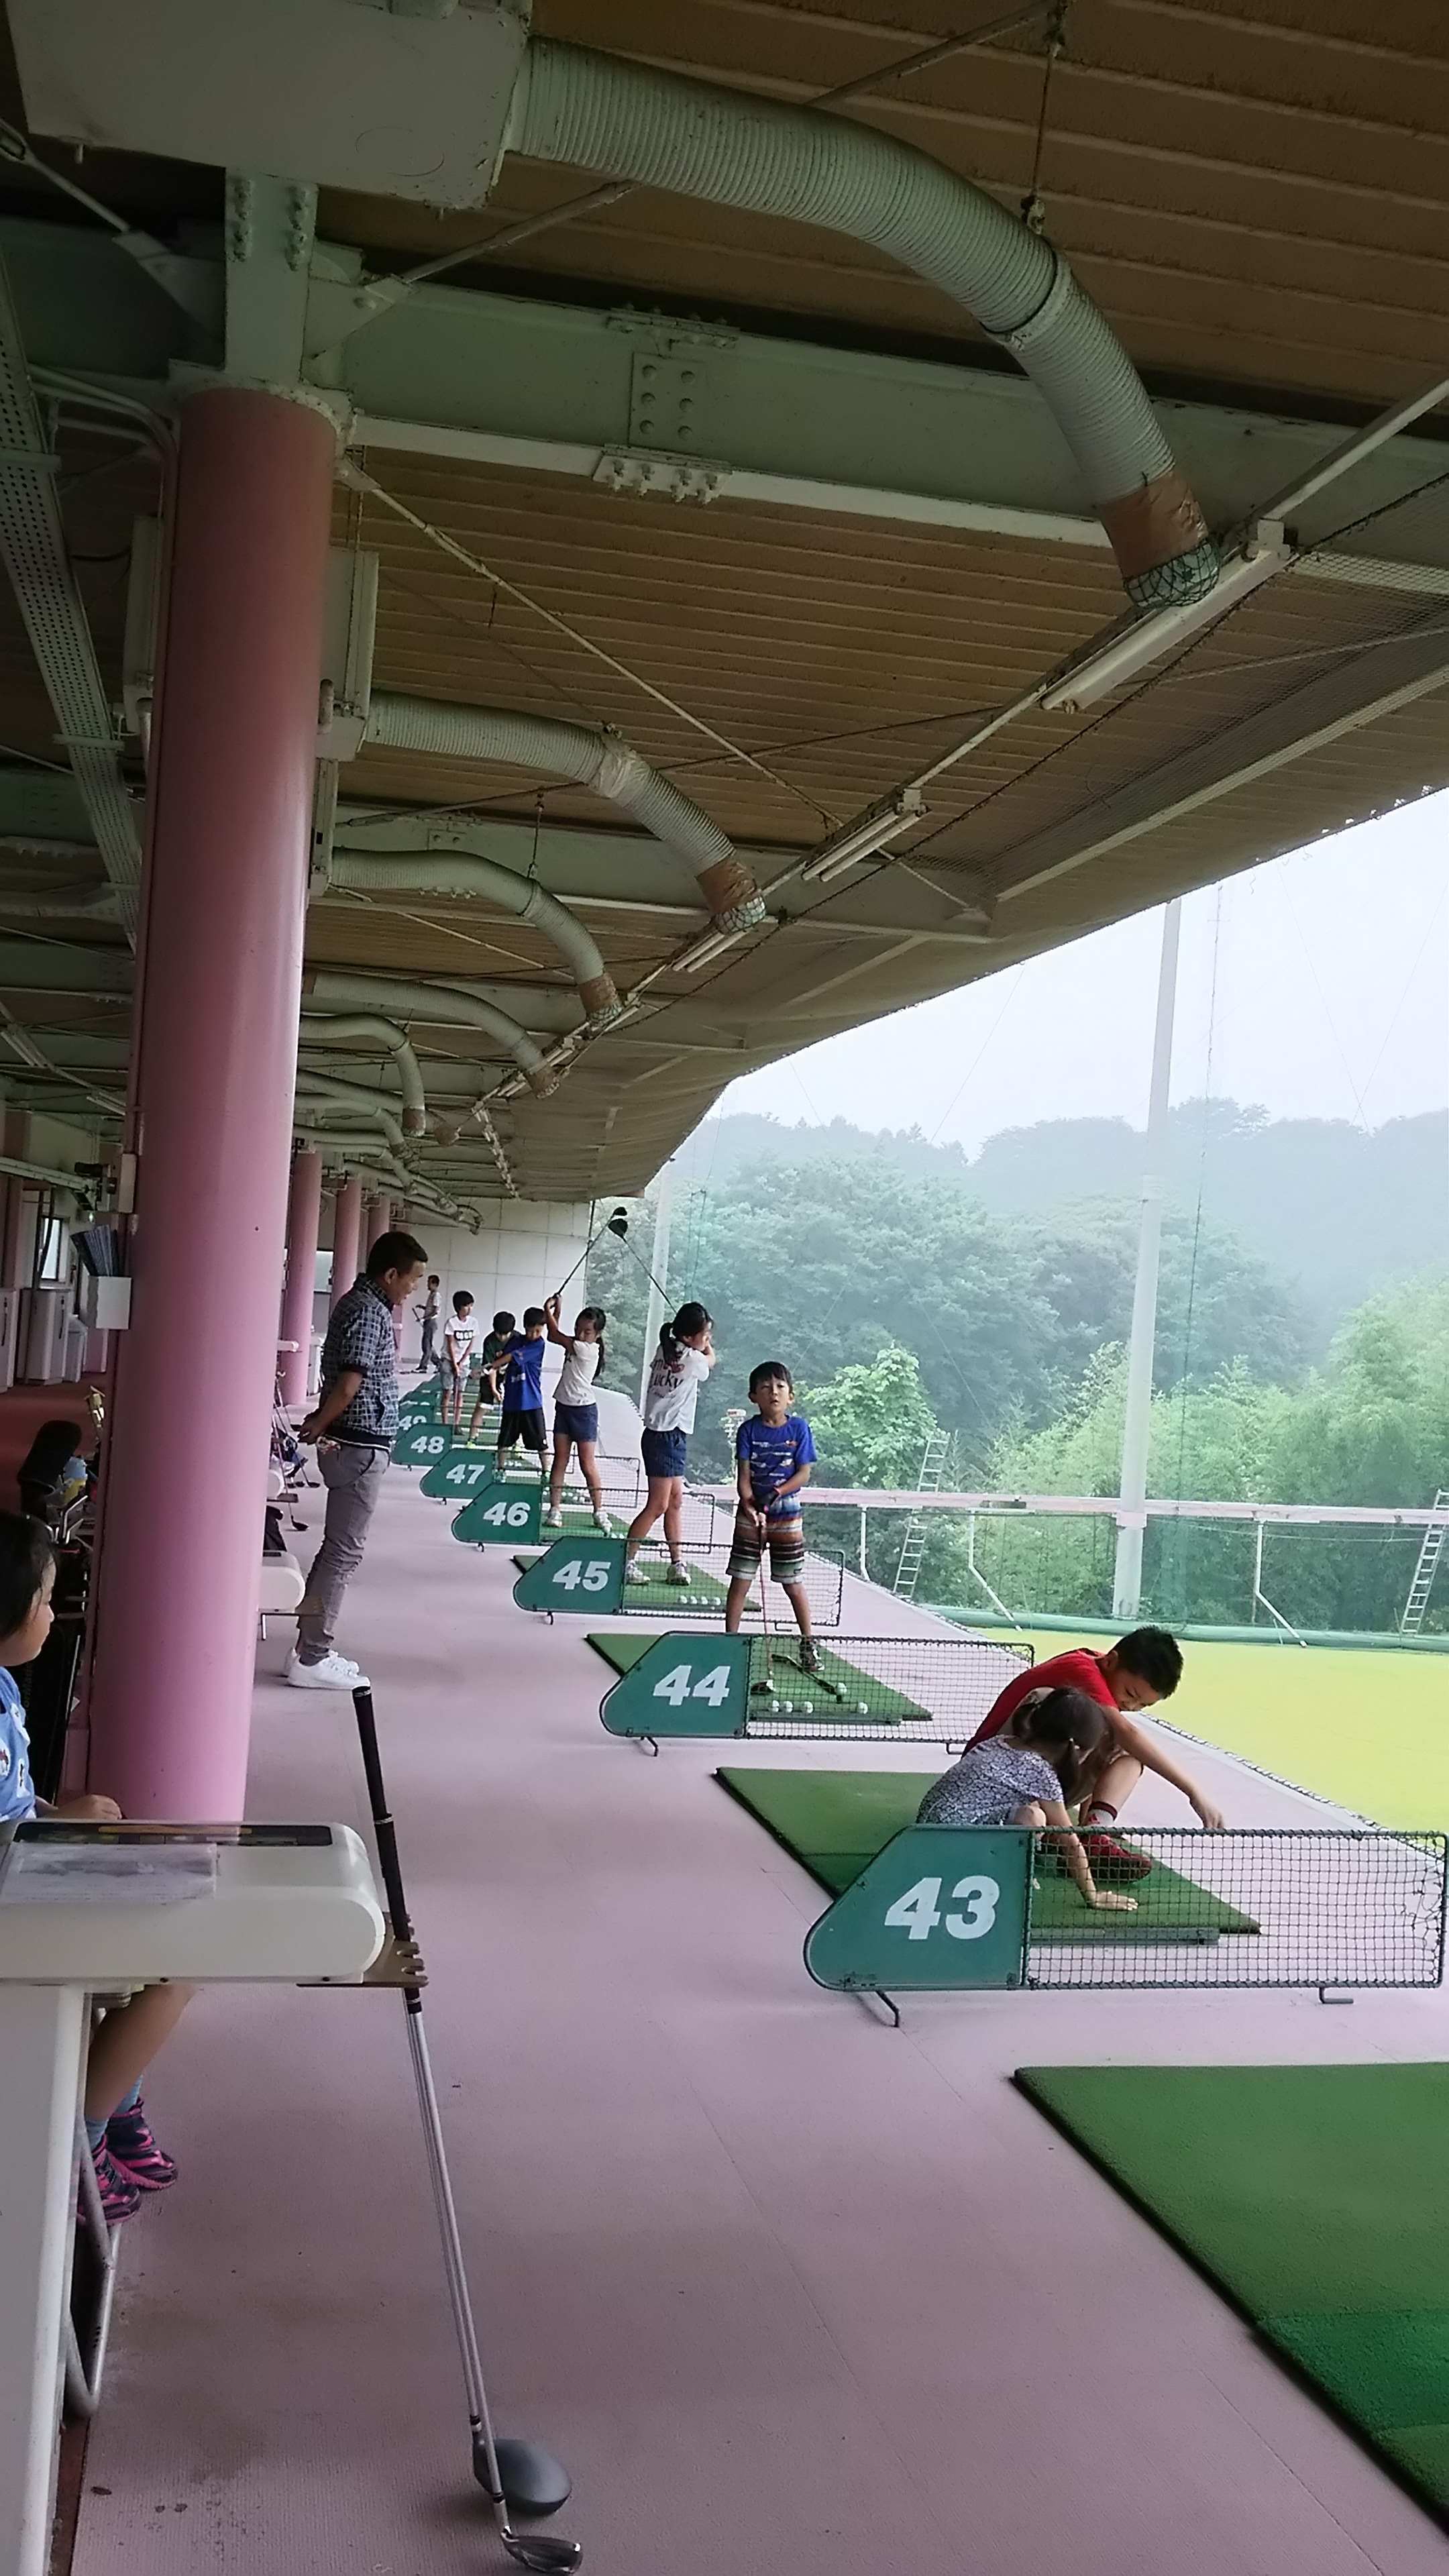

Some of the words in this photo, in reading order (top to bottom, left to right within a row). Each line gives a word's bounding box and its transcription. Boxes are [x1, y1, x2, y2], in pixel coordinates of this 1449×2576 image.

[411, 1436, 445, 1454] 48
[445, 1464, 486, 1485] 47
[483, 1502, 531, 1526] 46
[552, 1560, 611, 1591] 45
[653, 1665, 731, 1707] 44
[884, 1876, 1000, 1939] 43
